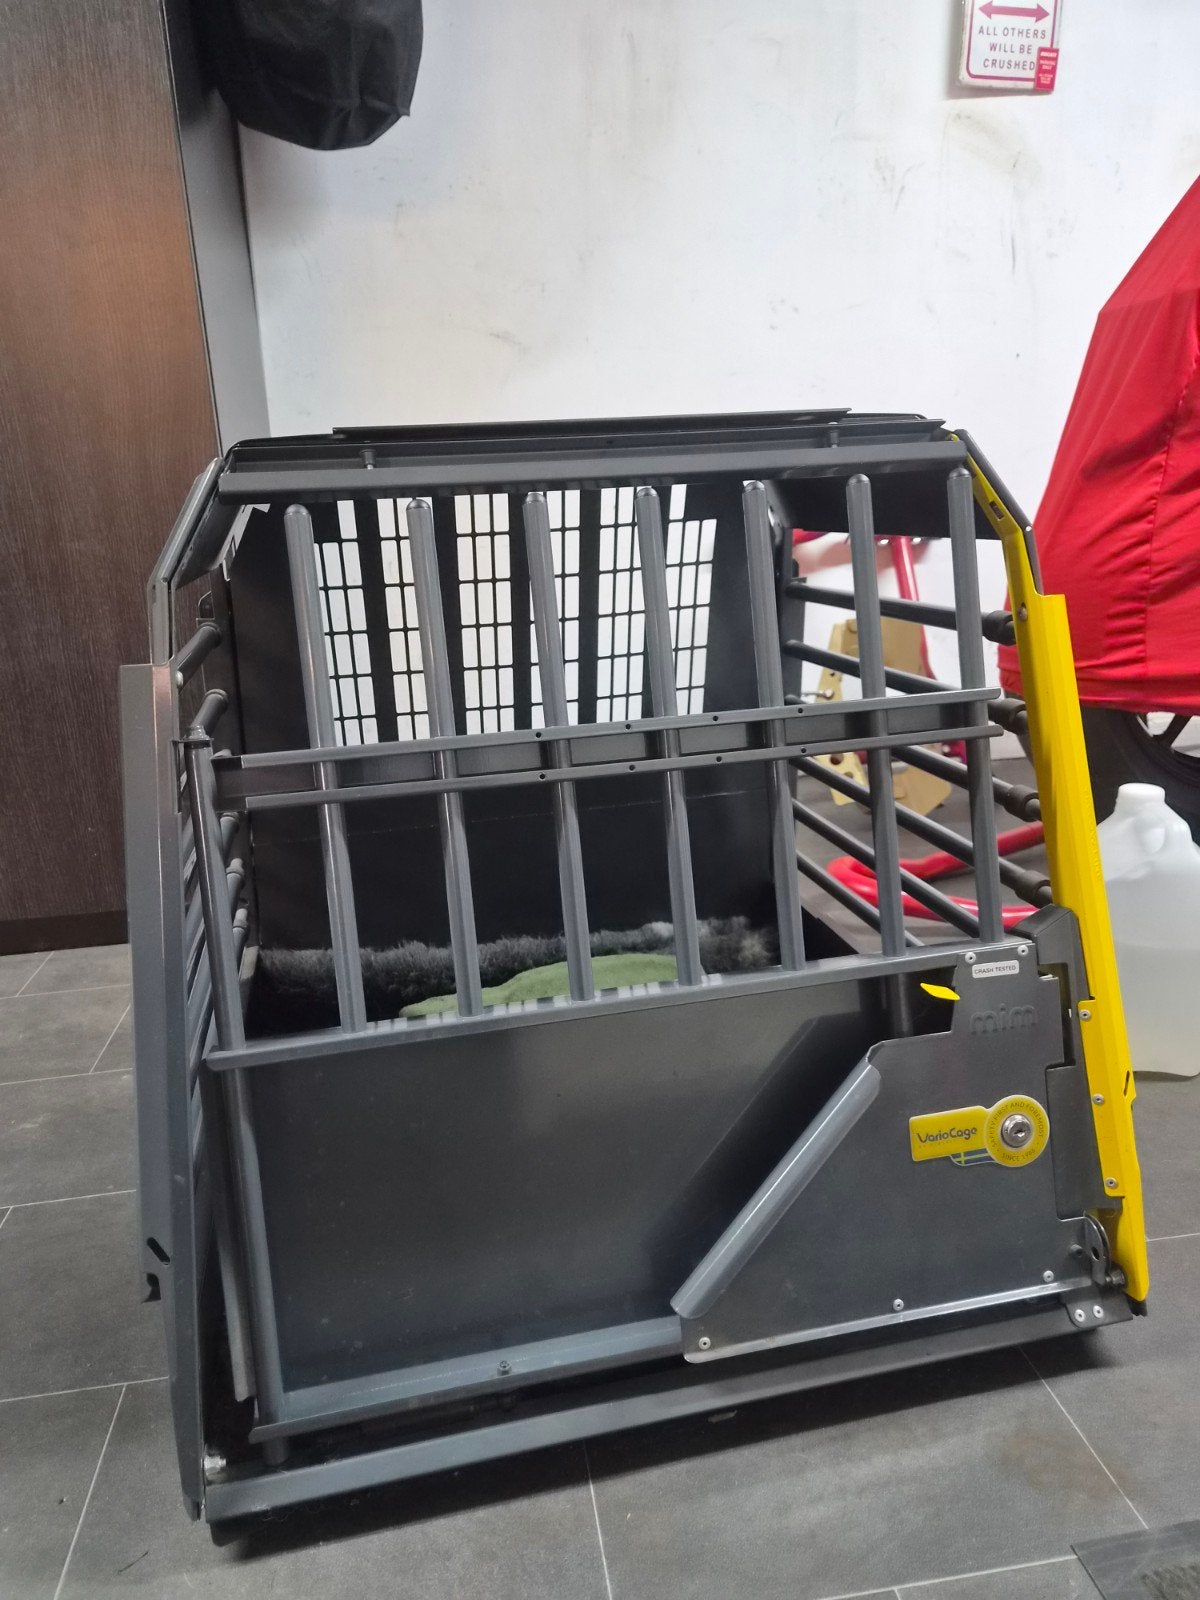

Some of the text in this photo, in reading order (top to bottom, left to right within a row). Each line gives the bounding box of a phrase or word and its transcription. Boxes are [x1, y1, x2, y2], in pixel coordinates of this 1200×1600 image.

[978, 25, 1046, 40] ALL OTHERS
[989, 42, 1015, 54] WILL
[1019, 44, 1033, 55] BE
[983, 58, 1036, 71] CRUSHED
[974, 967, 994, 975] CRASH
[1010, 1101, 1025, 1109] AND
[916, 1126, 978, 1144] VarioCage
